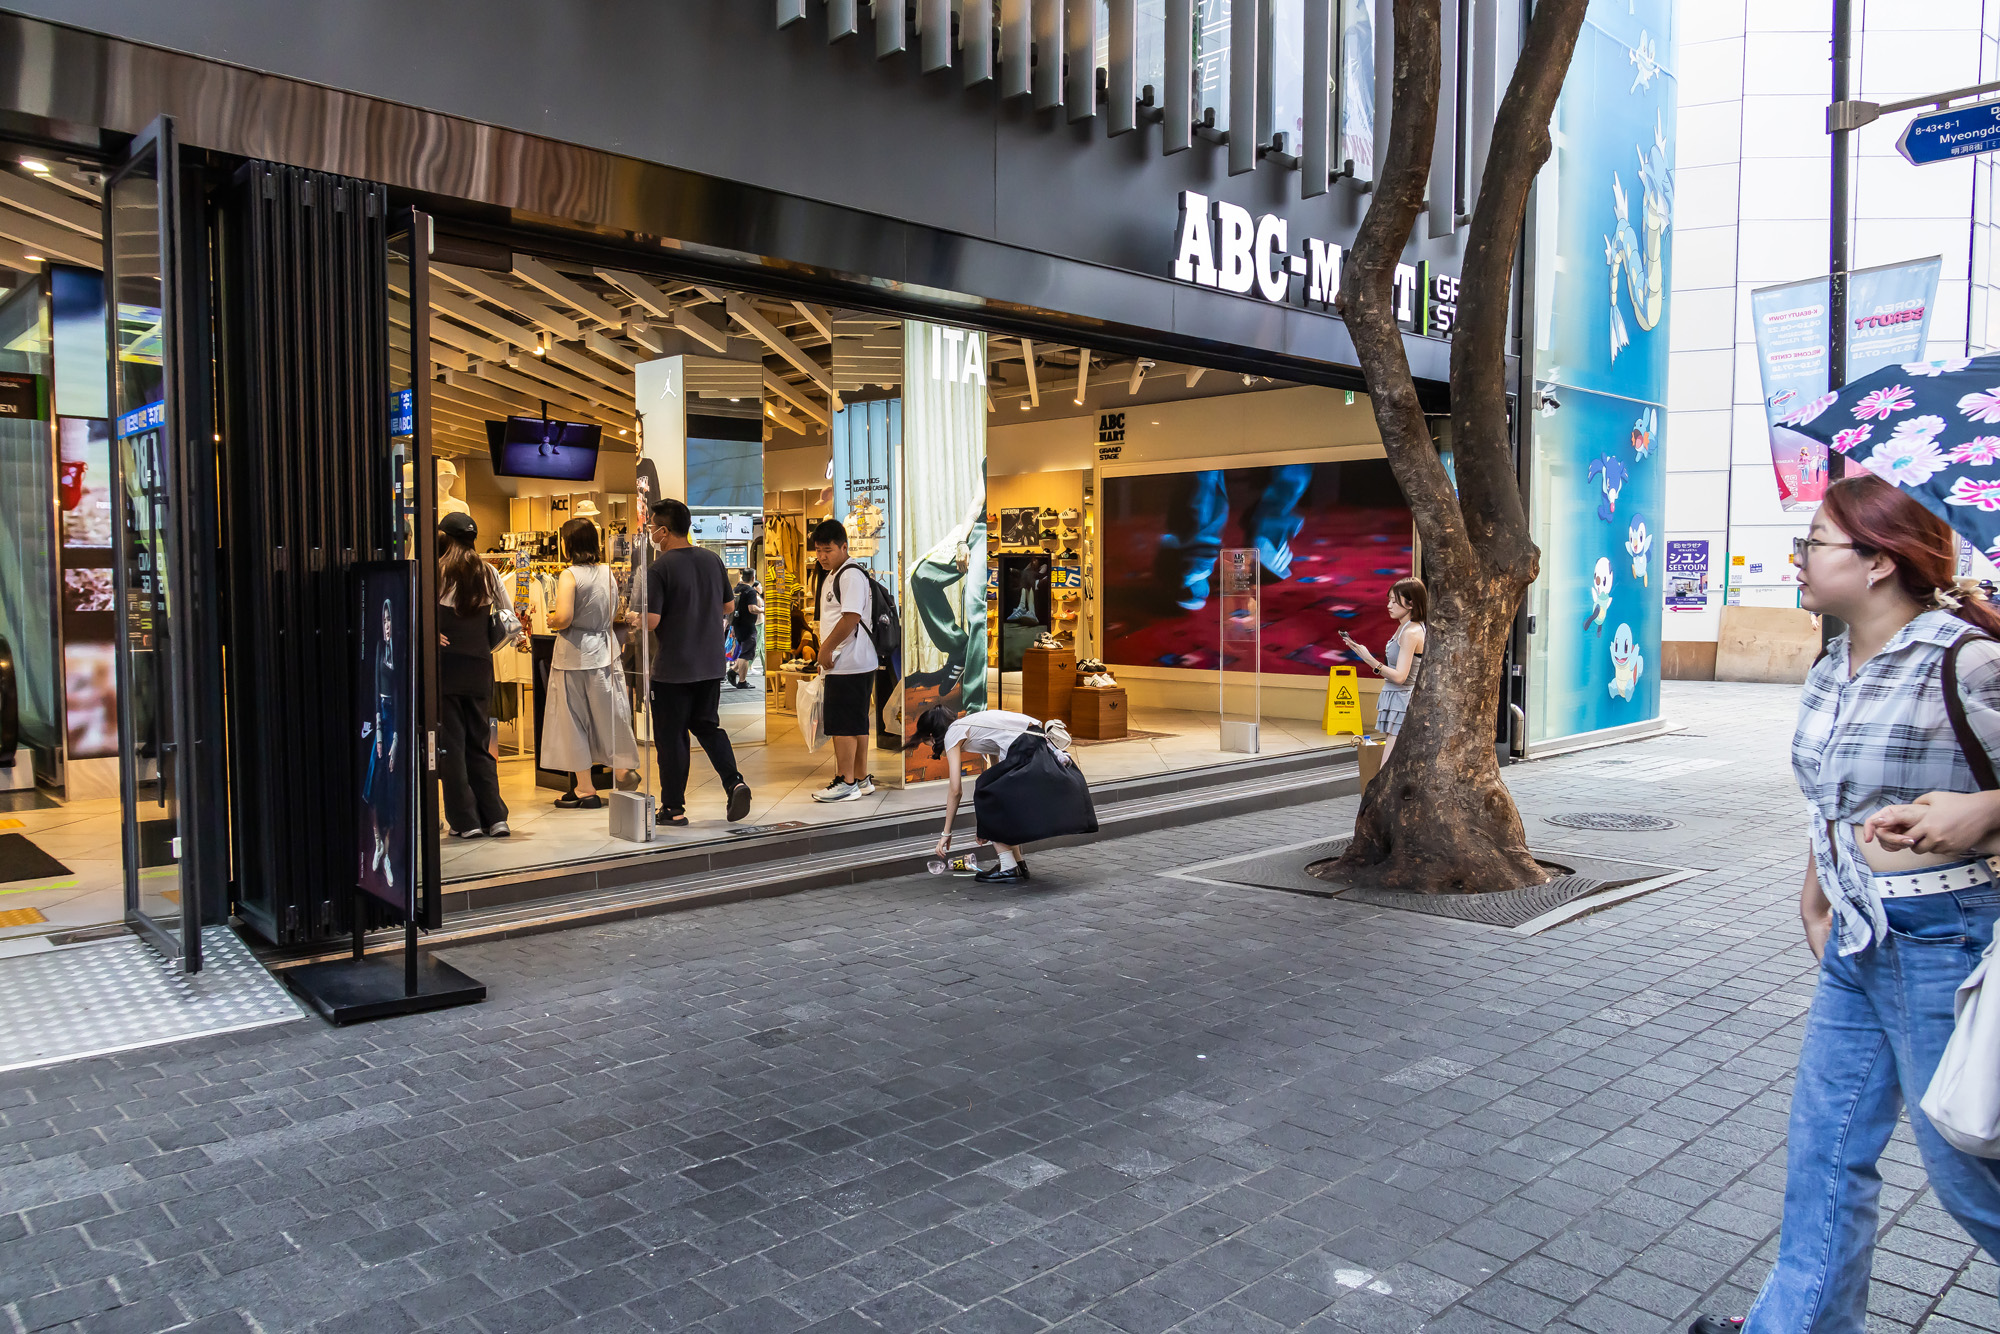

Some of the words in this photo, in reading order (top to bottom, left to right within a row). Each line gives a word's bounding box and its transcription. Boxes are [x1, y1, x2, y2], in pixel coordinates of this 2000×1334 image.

[1915, 124, 1937, 136] 8-43
[1944, 119, 1960, 130] 8-1
[1171, 190, 1417, 322] ABC-MT
[932, 325, 986, 386] ITA
[1099, 413, 1125, 430] ABC
[1099, 430, 1125, 442] MART
[551, 499, 568, 511] ACC
[1668, 563, 1706, 571] SEEYOUN
